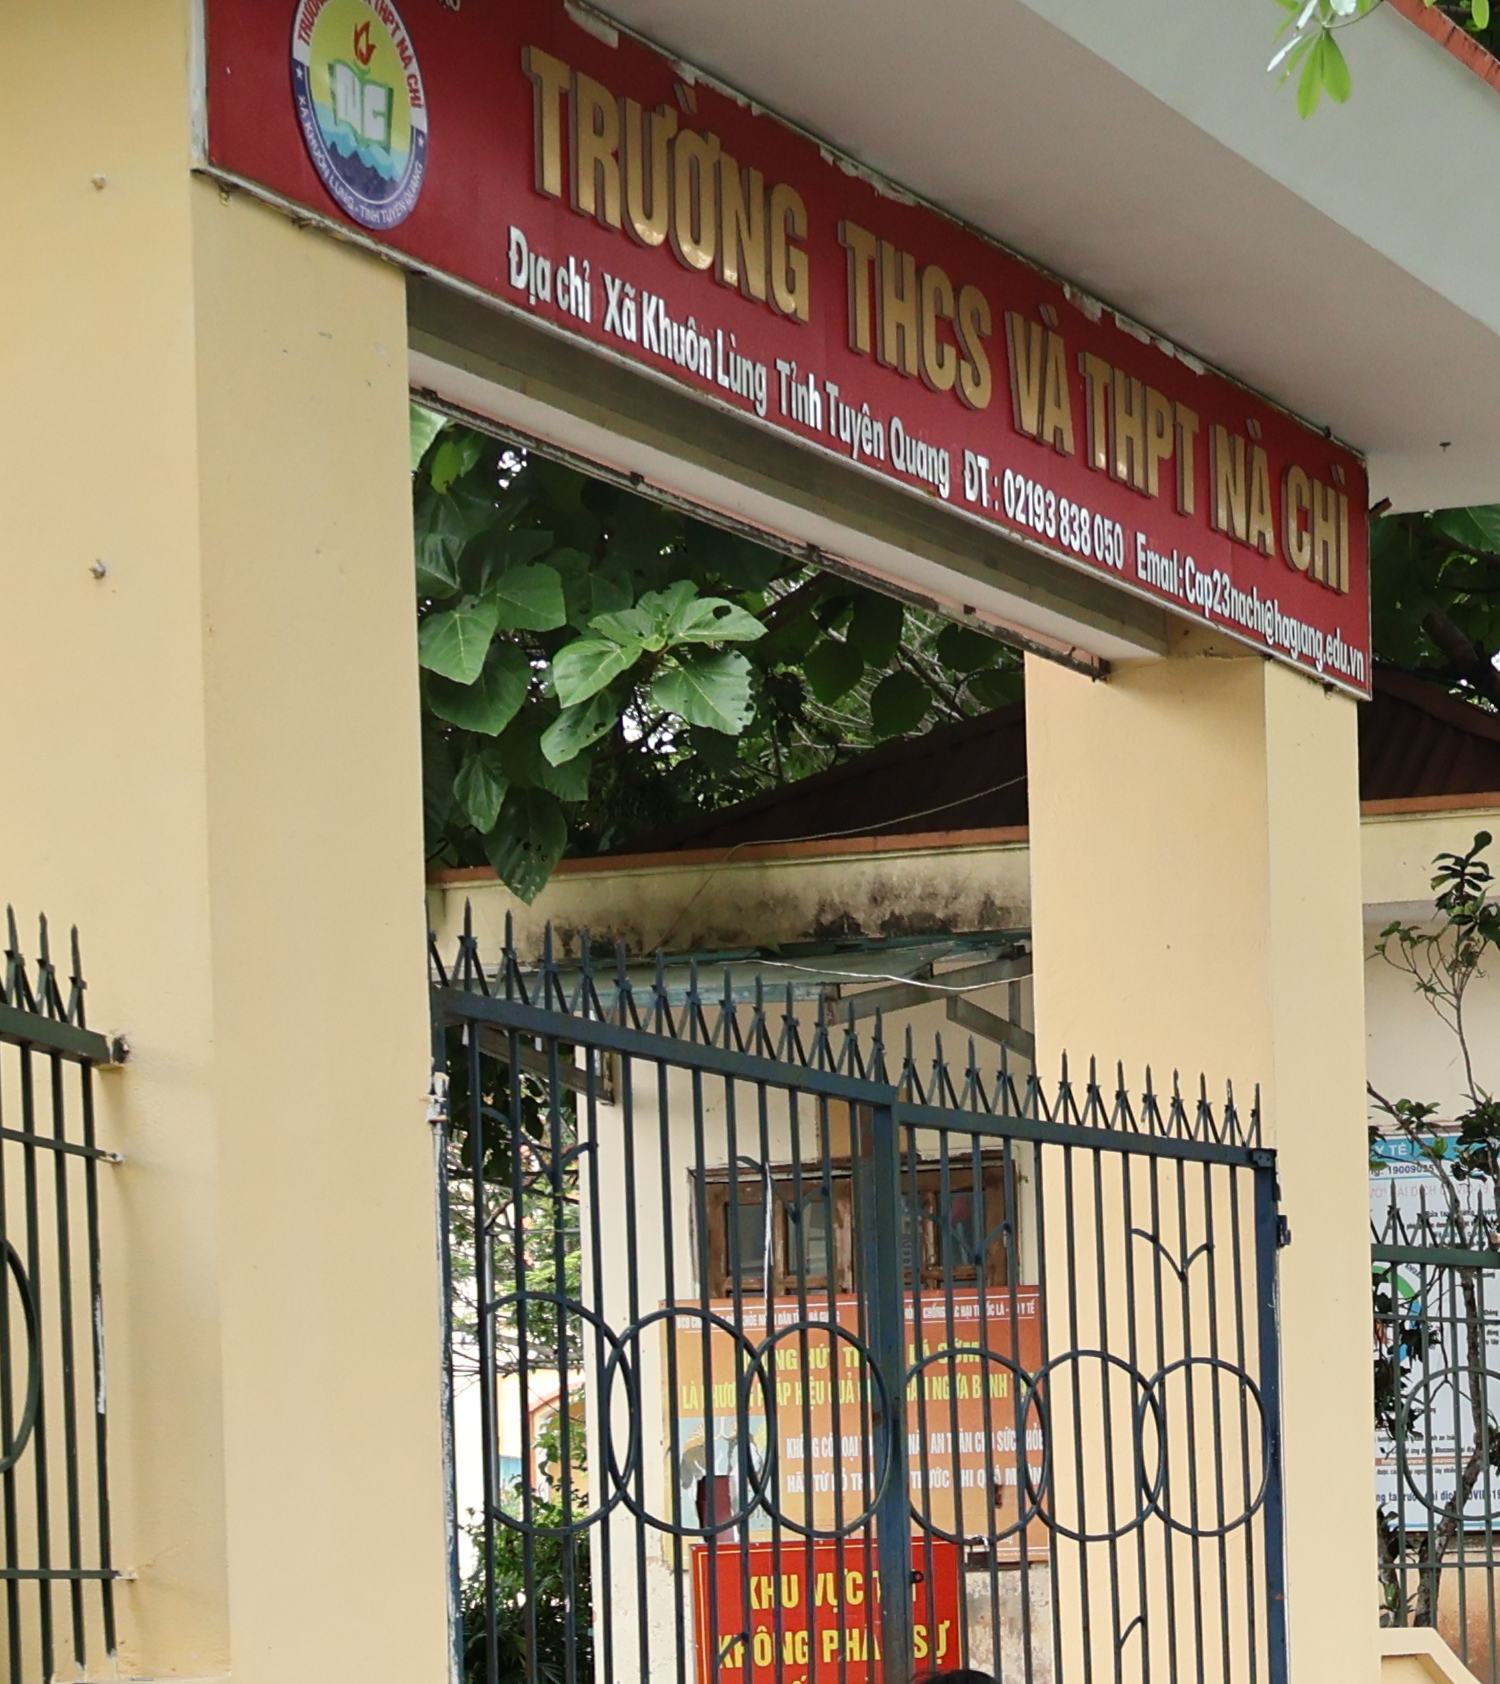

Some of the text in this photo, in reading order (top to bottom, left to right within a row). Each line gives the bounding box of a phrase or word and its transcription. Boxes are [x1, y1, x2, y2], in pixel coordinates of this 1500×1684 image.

[508, 226, 551, 306] Địa
[557, 256, 591, 323] chỉ
[602, 273, 637, 342] Xã
[642, 291, 712, 380] Khuôn
[716, 330, 768, 417] Lùng
[776, 359, 822, 431] Tỉnh
[827, 381, 885, 460] Tuyên
[890, 417, 950, 498] Quang
[1003, 468, 1056, 539] 02193
[521, 44, 1349, 595] TRƯỜNG THCS VÀ THPT NÀ CHÌ
